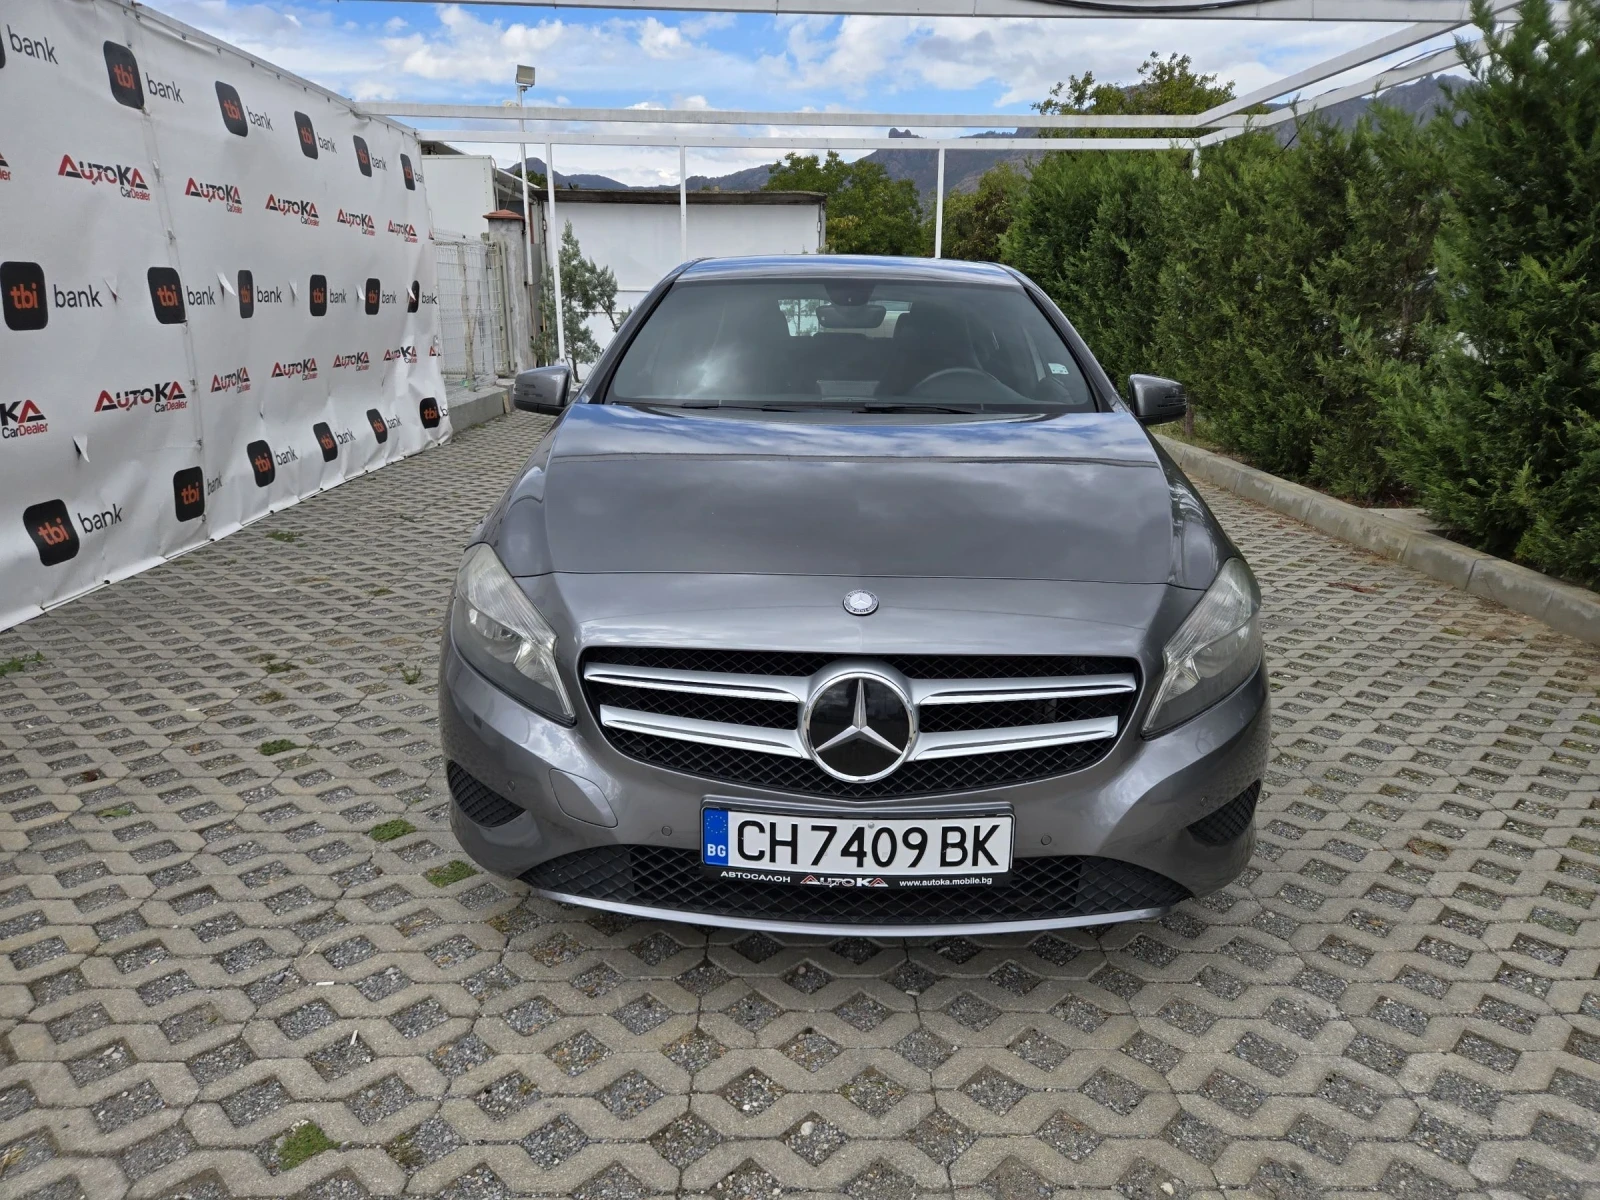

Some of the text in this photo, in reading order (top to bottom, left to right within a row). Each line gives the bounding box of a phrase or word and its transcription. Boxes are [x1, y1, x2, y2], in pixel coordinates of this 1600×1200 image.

[7, 24, 58, 65] bank
[113, 64, 184, 103] tbi bank
[223, 100, 273, 131] tbi bank
[300, 126, 337, 153] tbi bank
[371, 153, 387, 171] bank
[10, 282, 103, 309] tbi bank
[157, 285, 216, 307] tbi bank
[239, 285, 282, 304] tbi bank
[312, 287, 347, 304] tbi bank
[381, 290, 397, 304] bank
[154, 400, 188, 413] CarDealer
[424, 406, 438, 420] tbi
[2, 422, 49, 439] CarDealer
[335, 428, 356, 445] bank
[255, 446, 299, 473] tbi bank
[181, 472, 223, 505] tbi bank
[38, 504, 123, 546] tbi bank
[707, 843, 726, 857] BG
[720, 870, 791, 883] АВТОСАЛОН
[899, 876, 993, 887] www.autoka.mobile.bg
